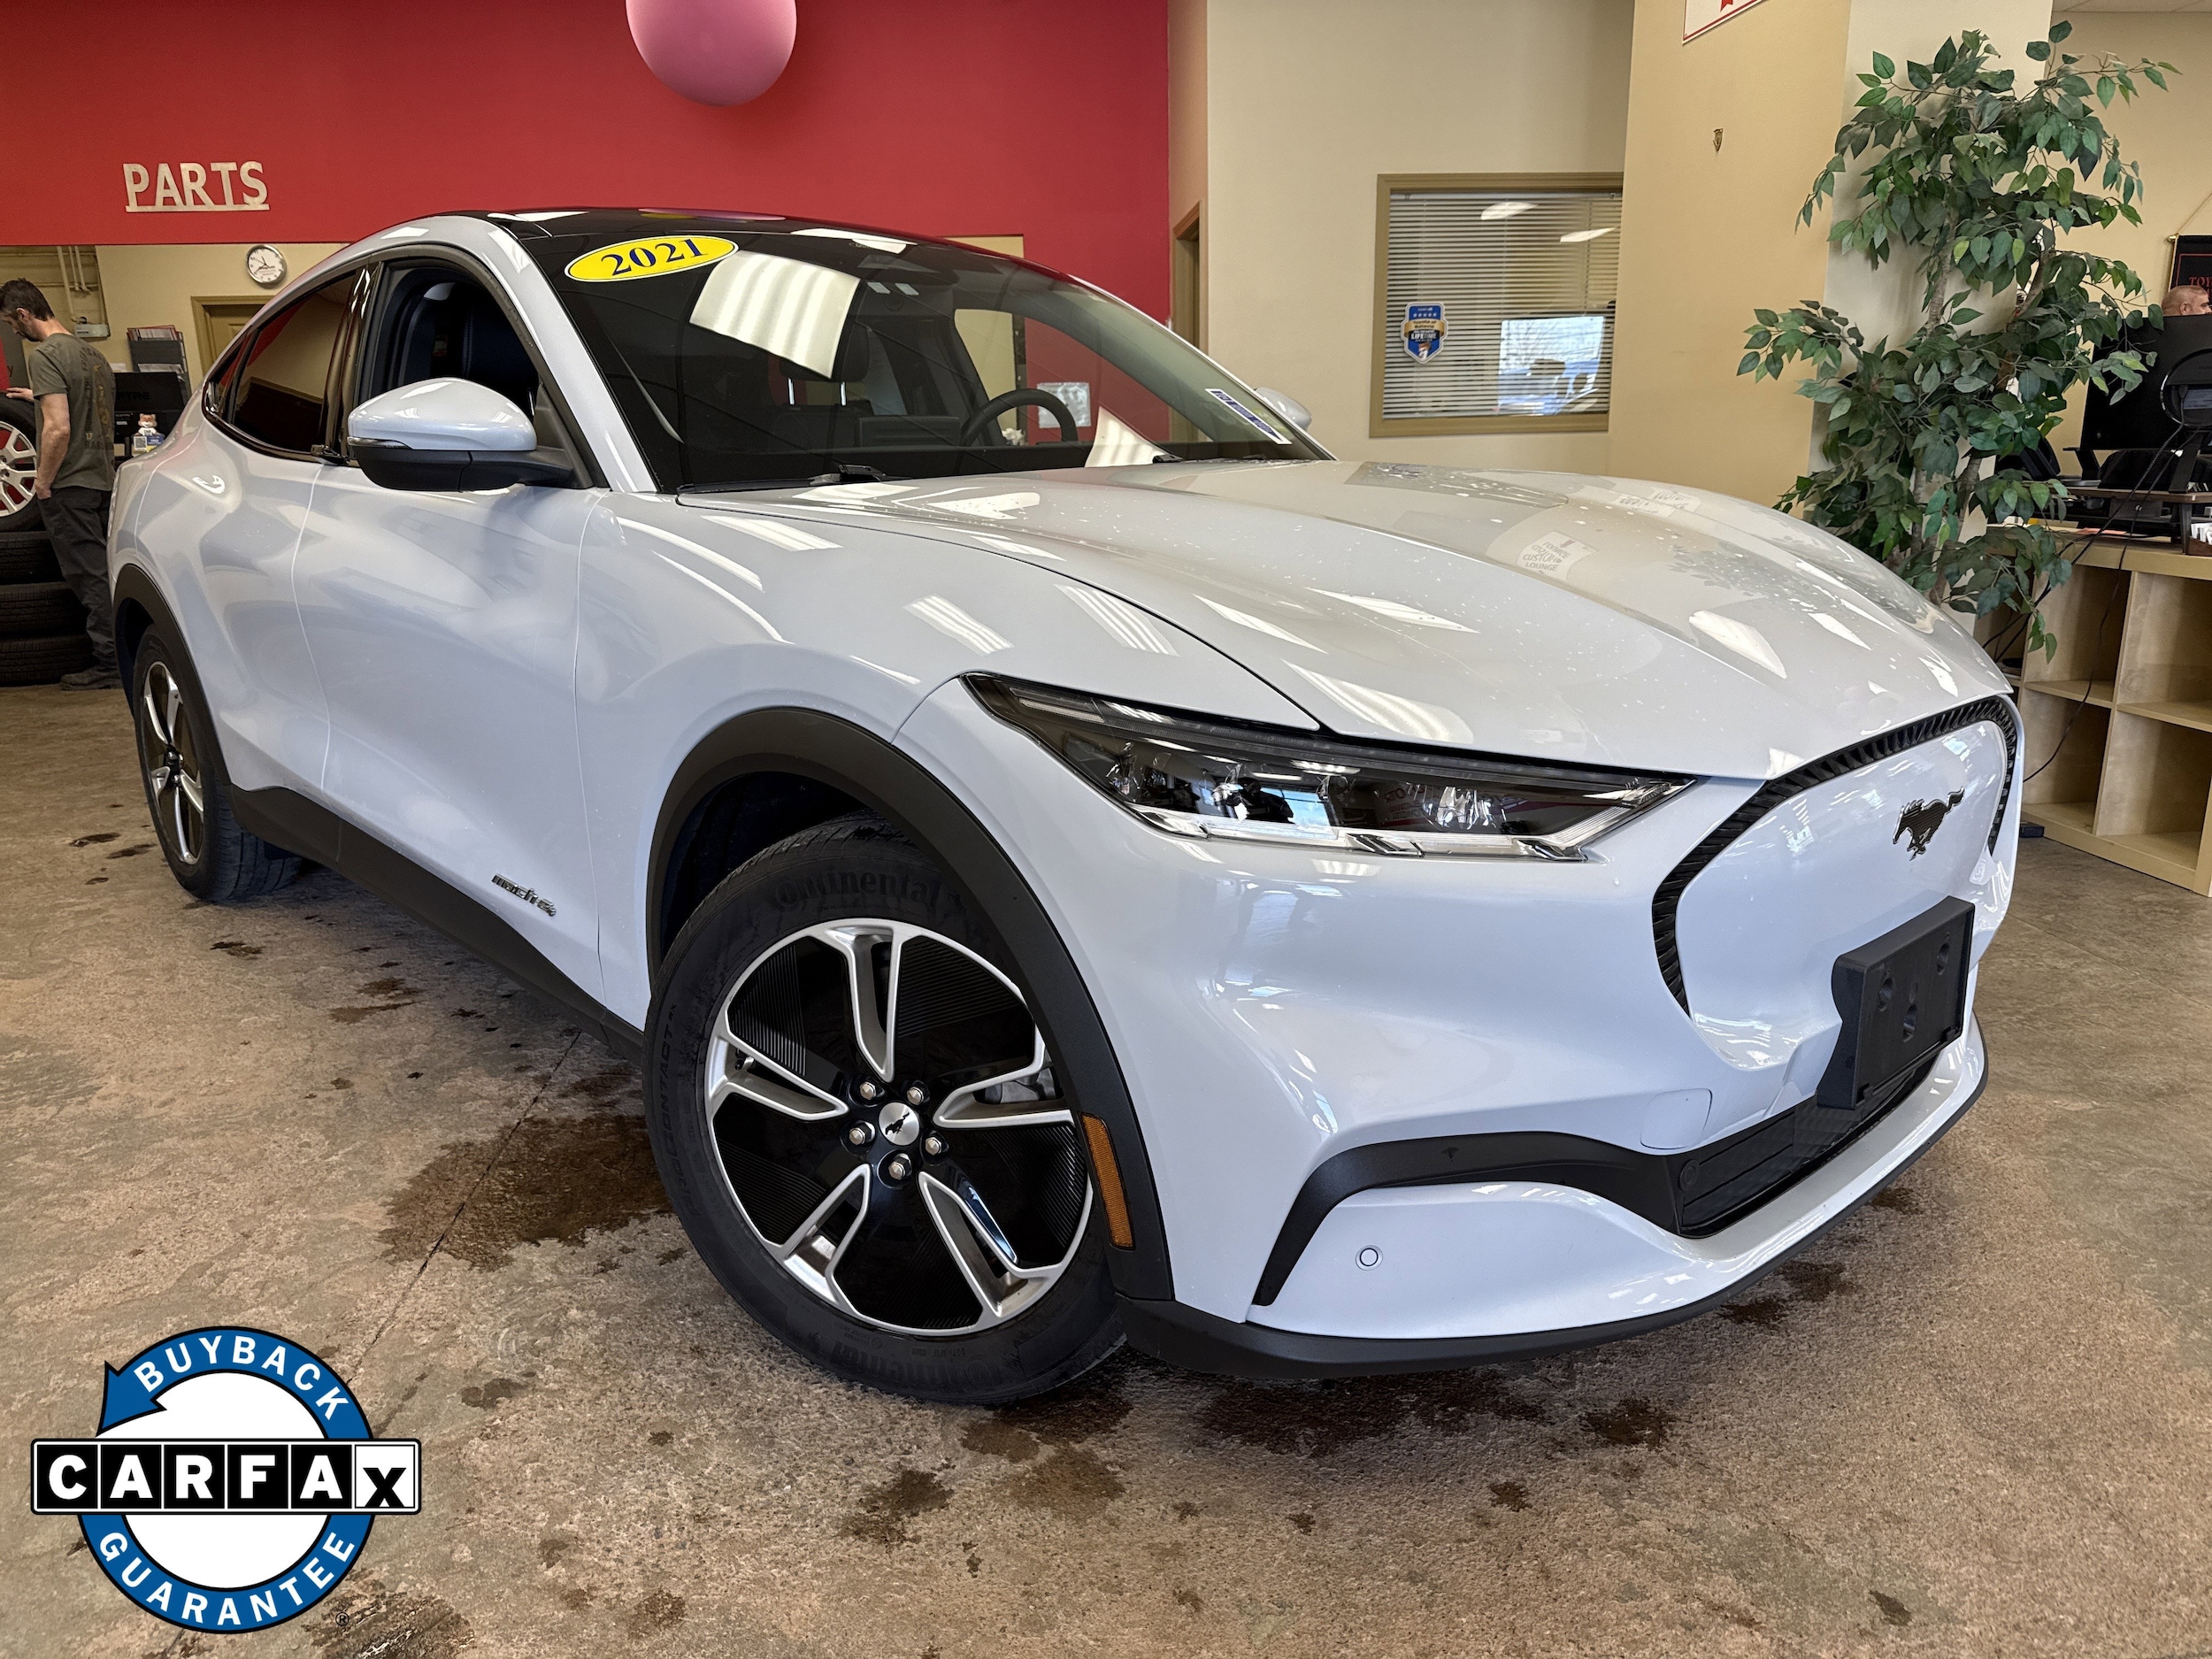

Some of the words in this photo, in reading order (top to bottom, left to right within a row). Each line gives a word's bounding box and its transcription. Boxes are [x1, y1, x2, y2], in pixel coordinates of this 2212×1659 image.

[122, 160, 269, 209] PARTS
[600, 238, 709, 276] 2021
[1525, 562, 1559, 572] LOUNGE
[766, 864, 942, 911] Continental
